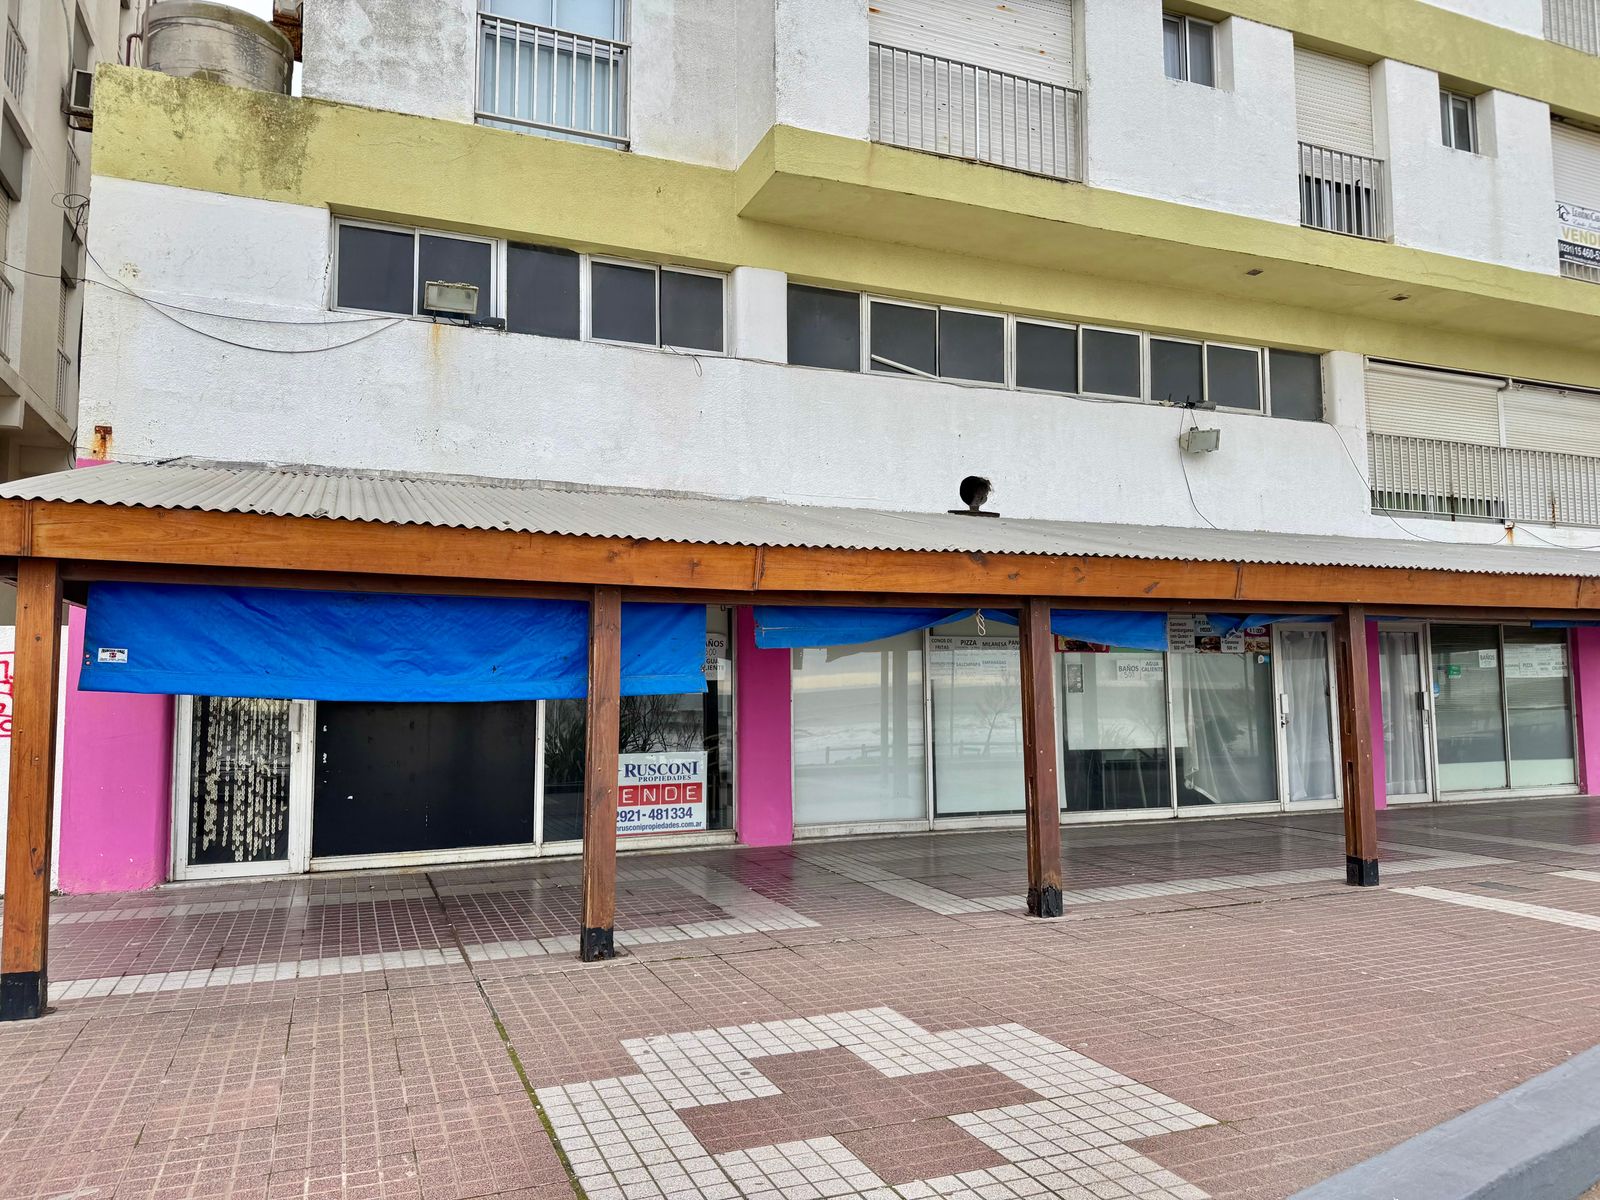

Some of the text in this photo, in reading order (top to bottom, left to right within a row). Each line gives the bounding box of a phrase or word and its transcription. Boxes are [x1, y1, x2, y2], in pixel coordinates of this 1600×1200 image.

[1561, 226, 1600, 247] VEND
[624, 761, 699, 778] RUSCONI
[622, 785, 698, 803] ENDE
